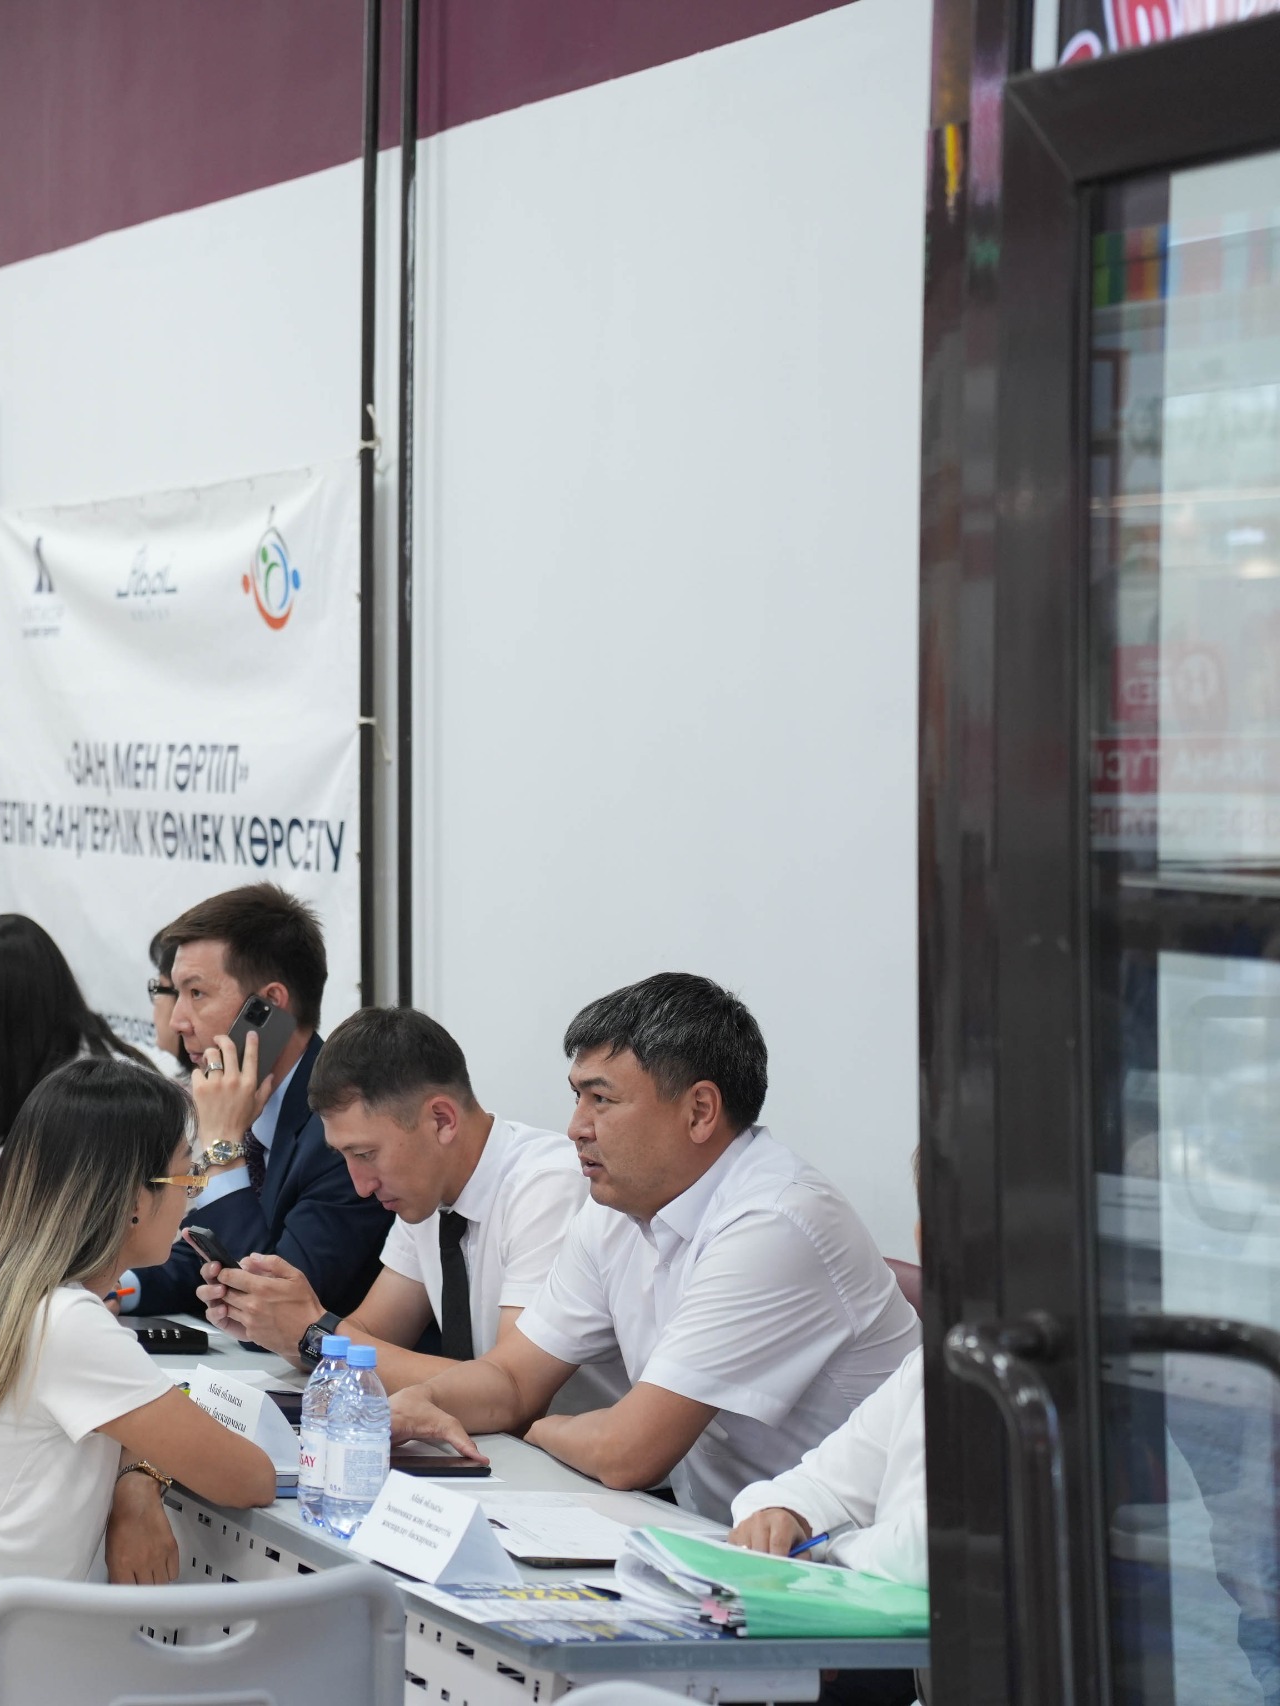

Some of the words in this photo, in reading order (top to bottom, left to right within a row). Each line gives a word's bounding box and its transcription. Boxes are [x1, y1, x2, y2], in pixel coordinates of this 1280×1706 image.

[114, 743, 161, 790] МЕН
[40, 803, 144, 859] ЗАҢГЕРЛІК
[146, 811, 226, 865] КӨМЕК
[232, 816, 345, 872] КӨРСЕТУ
